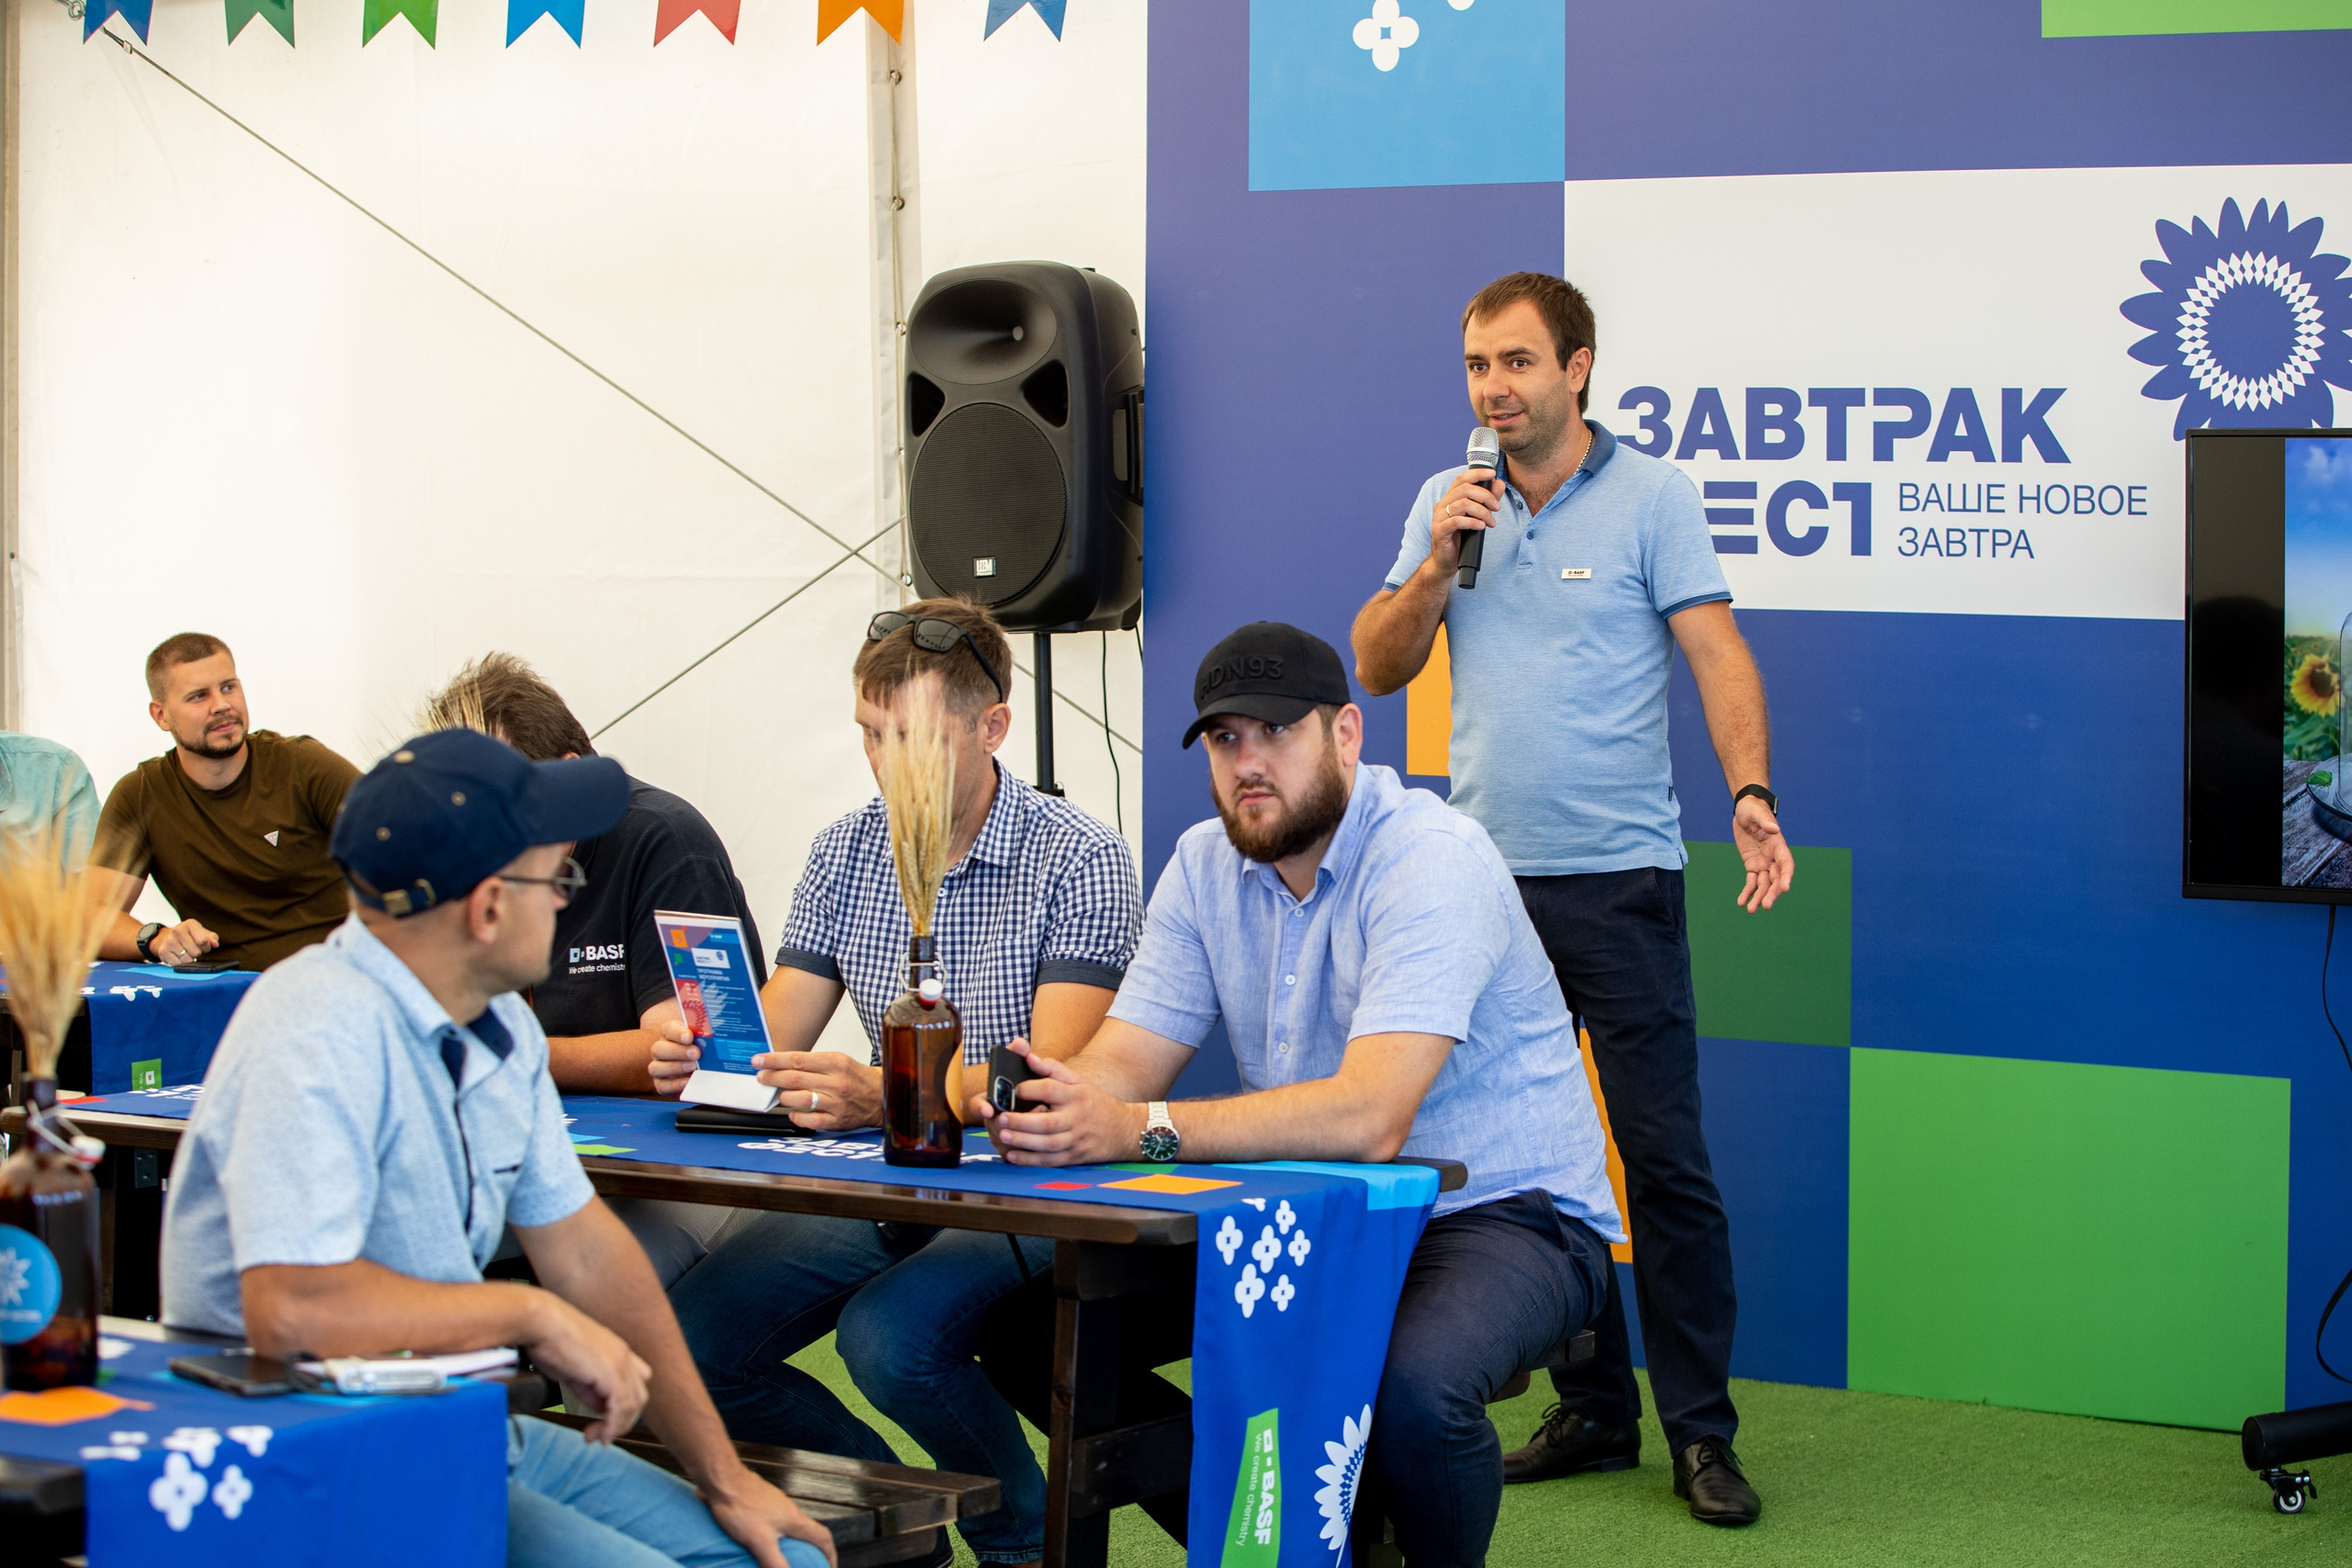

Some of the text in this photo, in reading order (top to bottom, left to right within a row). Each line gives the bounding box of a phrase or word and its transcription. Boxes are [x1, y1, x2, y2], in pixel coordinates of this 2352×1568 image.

[1616, 386, 2072, 464] ЗАВТРАК
[1702, 479, 1872, 557] ЕСТ
[1898, 482, 2148, 516] ВАШЕ НОВОЕ
[1896, 526, 2035, 559] ЗАВТРА
[578, 964, 595, 973] create
[596, 963, 626, 972] chemistr
[1235, 1433, 1262, 1547] We create chemistry
[1254, 1470, 1275, 1545] BASF
